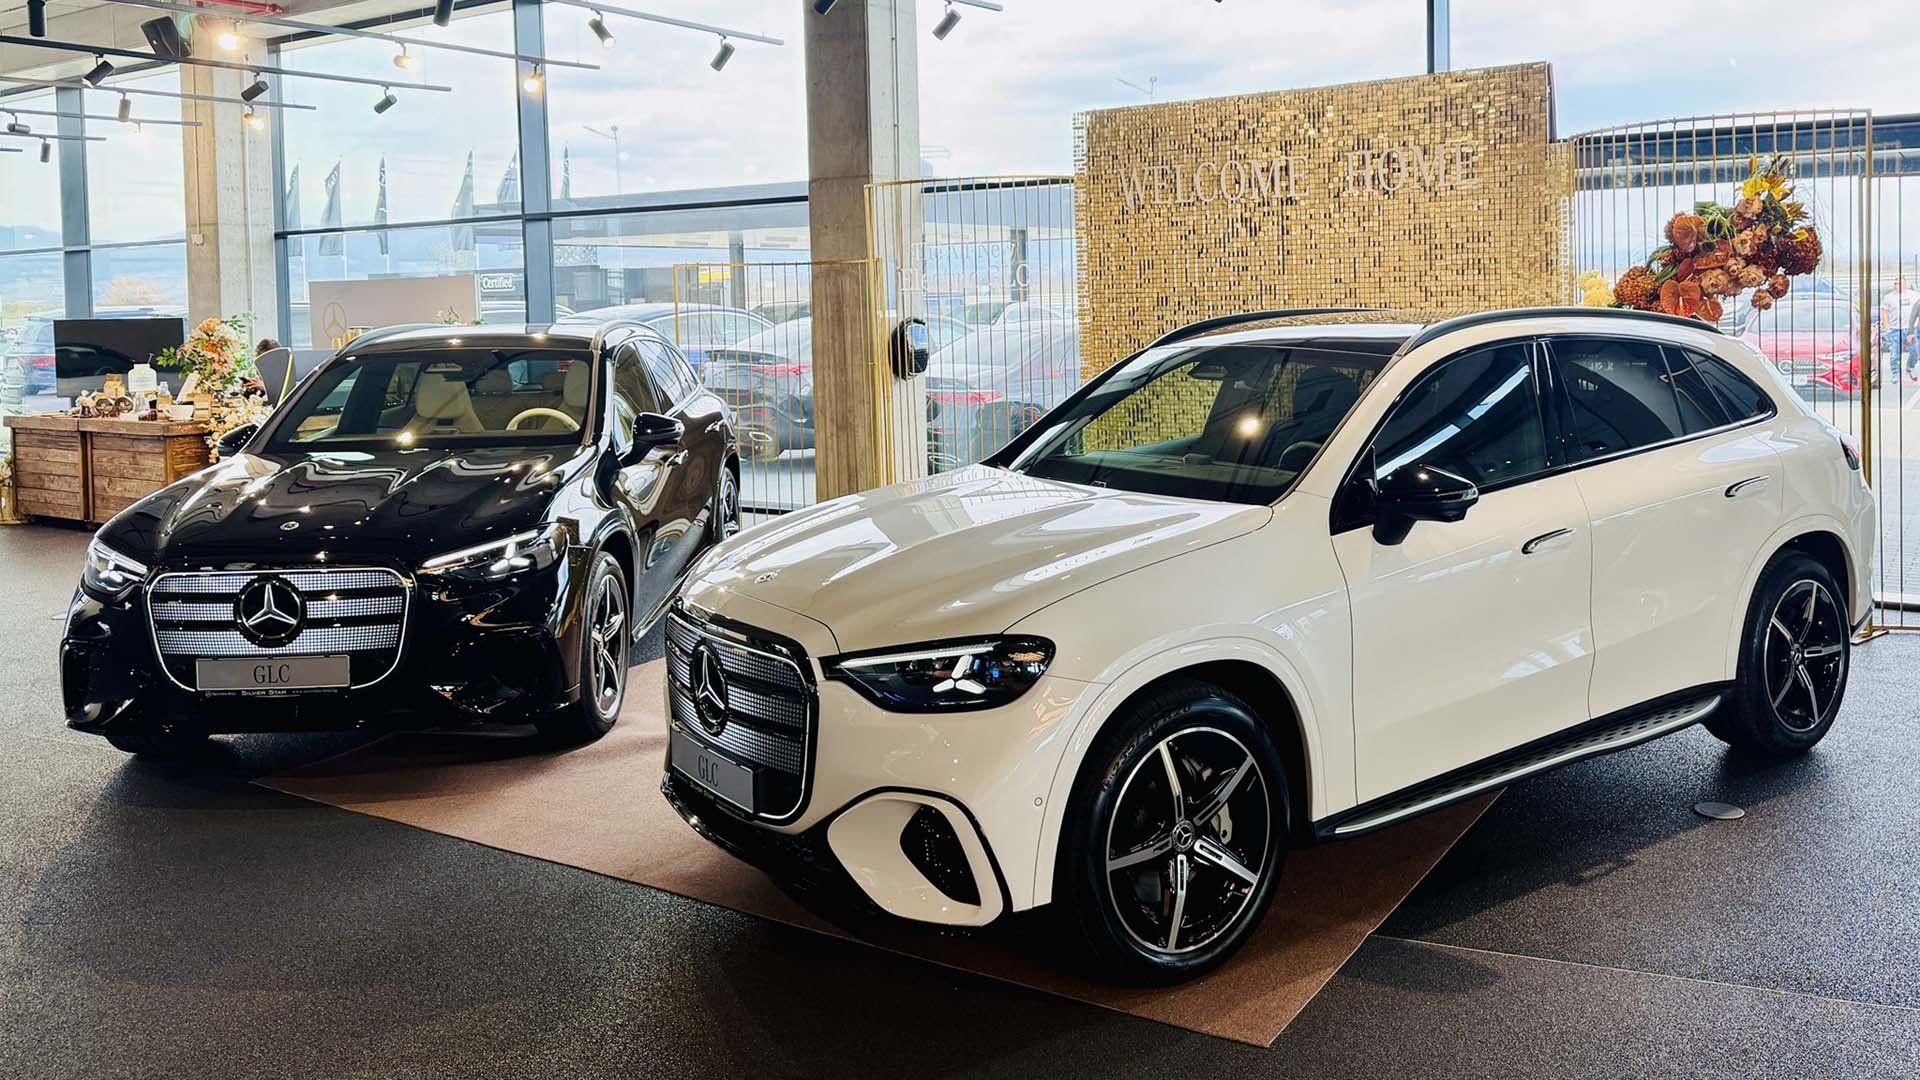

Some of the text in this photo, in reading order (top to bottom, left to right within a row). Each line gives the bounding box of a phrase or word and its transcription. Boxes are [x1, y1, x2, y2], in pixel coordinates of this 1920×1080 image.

[1119, 141, 1479, 210] WELCOME HOME
[482, 276, 513, 289] Certified
[253, 664, 291, 684] GLC
[697, 754, 719, 787] GLC
